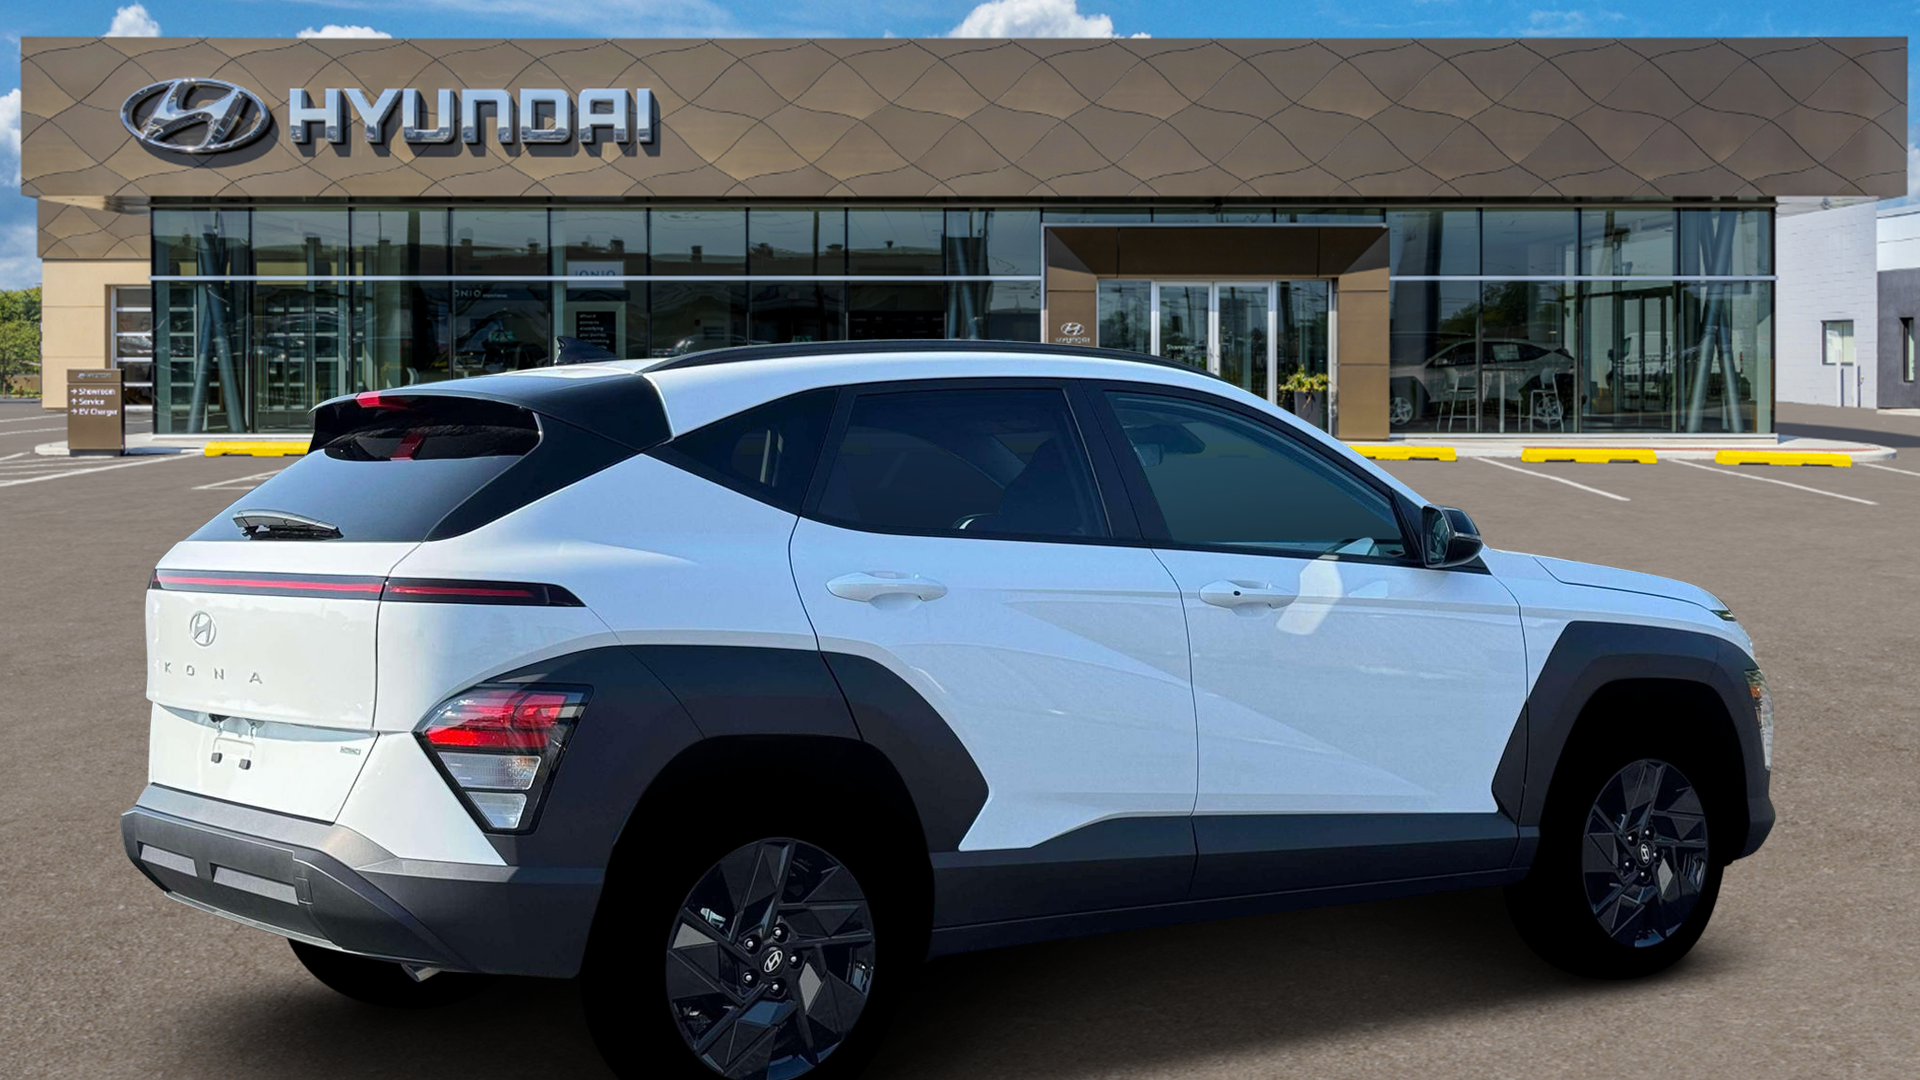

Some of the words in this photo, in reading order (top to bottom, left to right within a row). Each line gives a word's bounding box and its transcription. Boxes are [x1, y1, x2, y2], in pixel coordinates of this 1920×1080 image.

[289, 88, 655, 145] HYUNDAI
[78, 387, 116, 395] Showroom
[78, 397, 105, 405] Service
[90, 408, 118, 417] Charger
[164, 661, 263, 685] KONA
